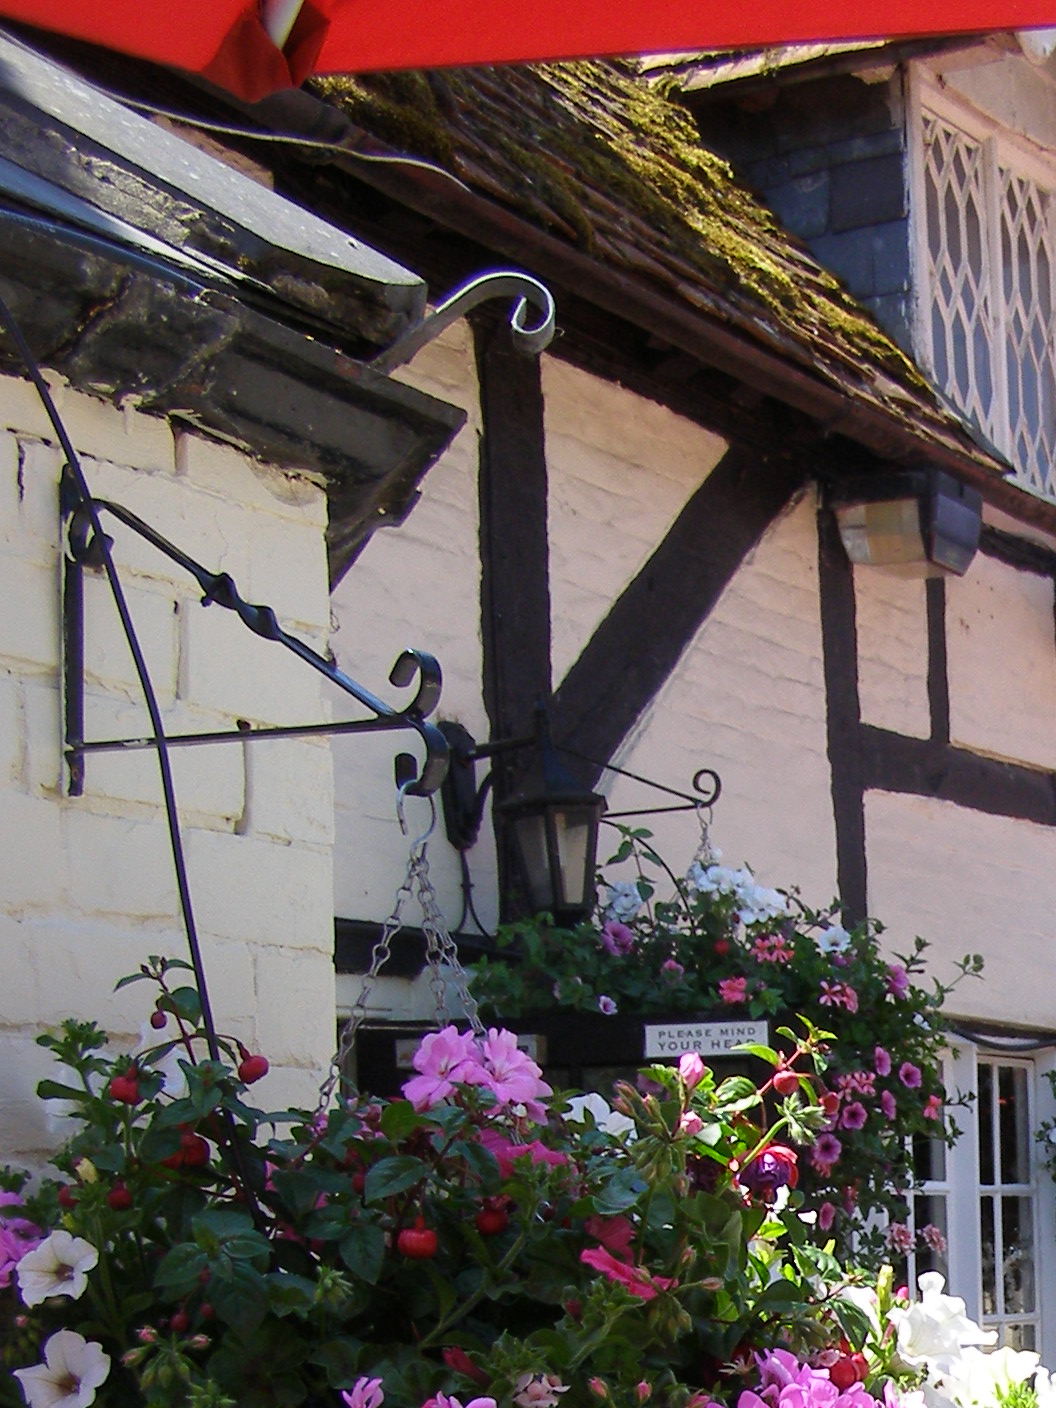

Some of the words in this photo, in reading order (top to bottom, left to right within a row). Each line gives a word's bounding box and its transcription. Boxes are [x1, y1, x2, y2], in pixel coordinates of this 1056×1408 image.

[658, 1029, 712, 1039] PLEASE
[720, 1027, 756, 1036] MIND
[658, 1041, 702, 1051] YOUR
